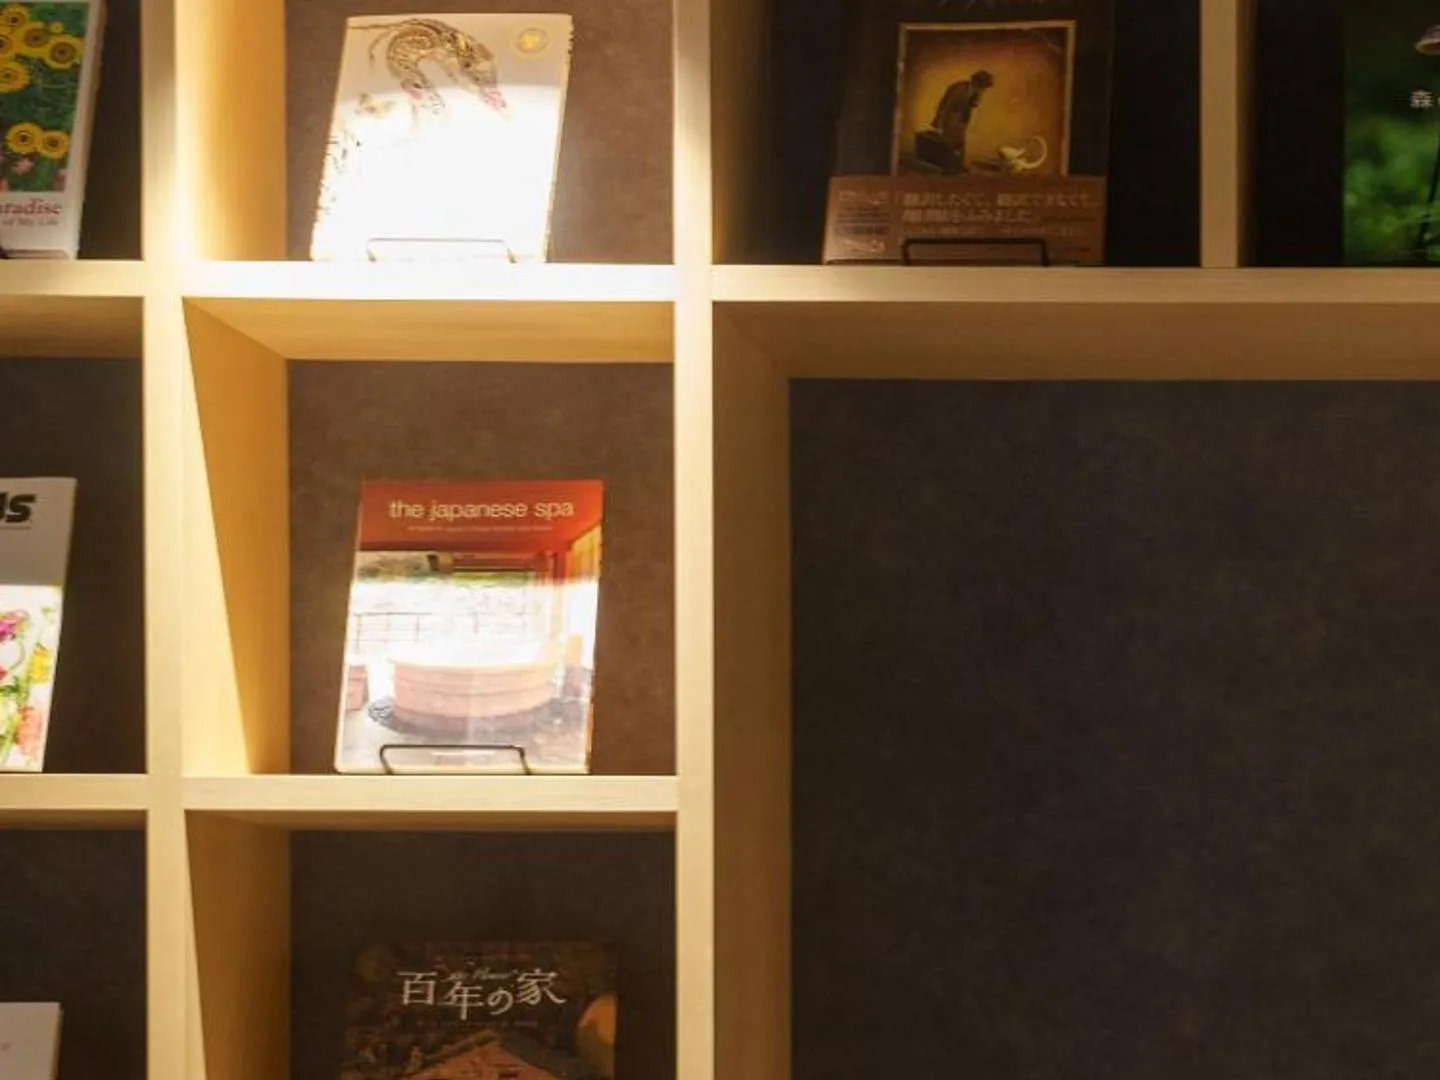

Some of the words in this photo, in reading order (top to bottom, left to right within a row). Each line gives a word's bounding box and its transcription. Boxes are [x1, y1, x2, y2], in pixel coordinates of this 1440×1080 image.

[0, 197, 61, 215] radise
[388, 500, 425, 518] the
[428, 500, 528, 522] japanese
[534, 501, 575, 521] spa
[397, 968, 567, 1021] 百年の家
